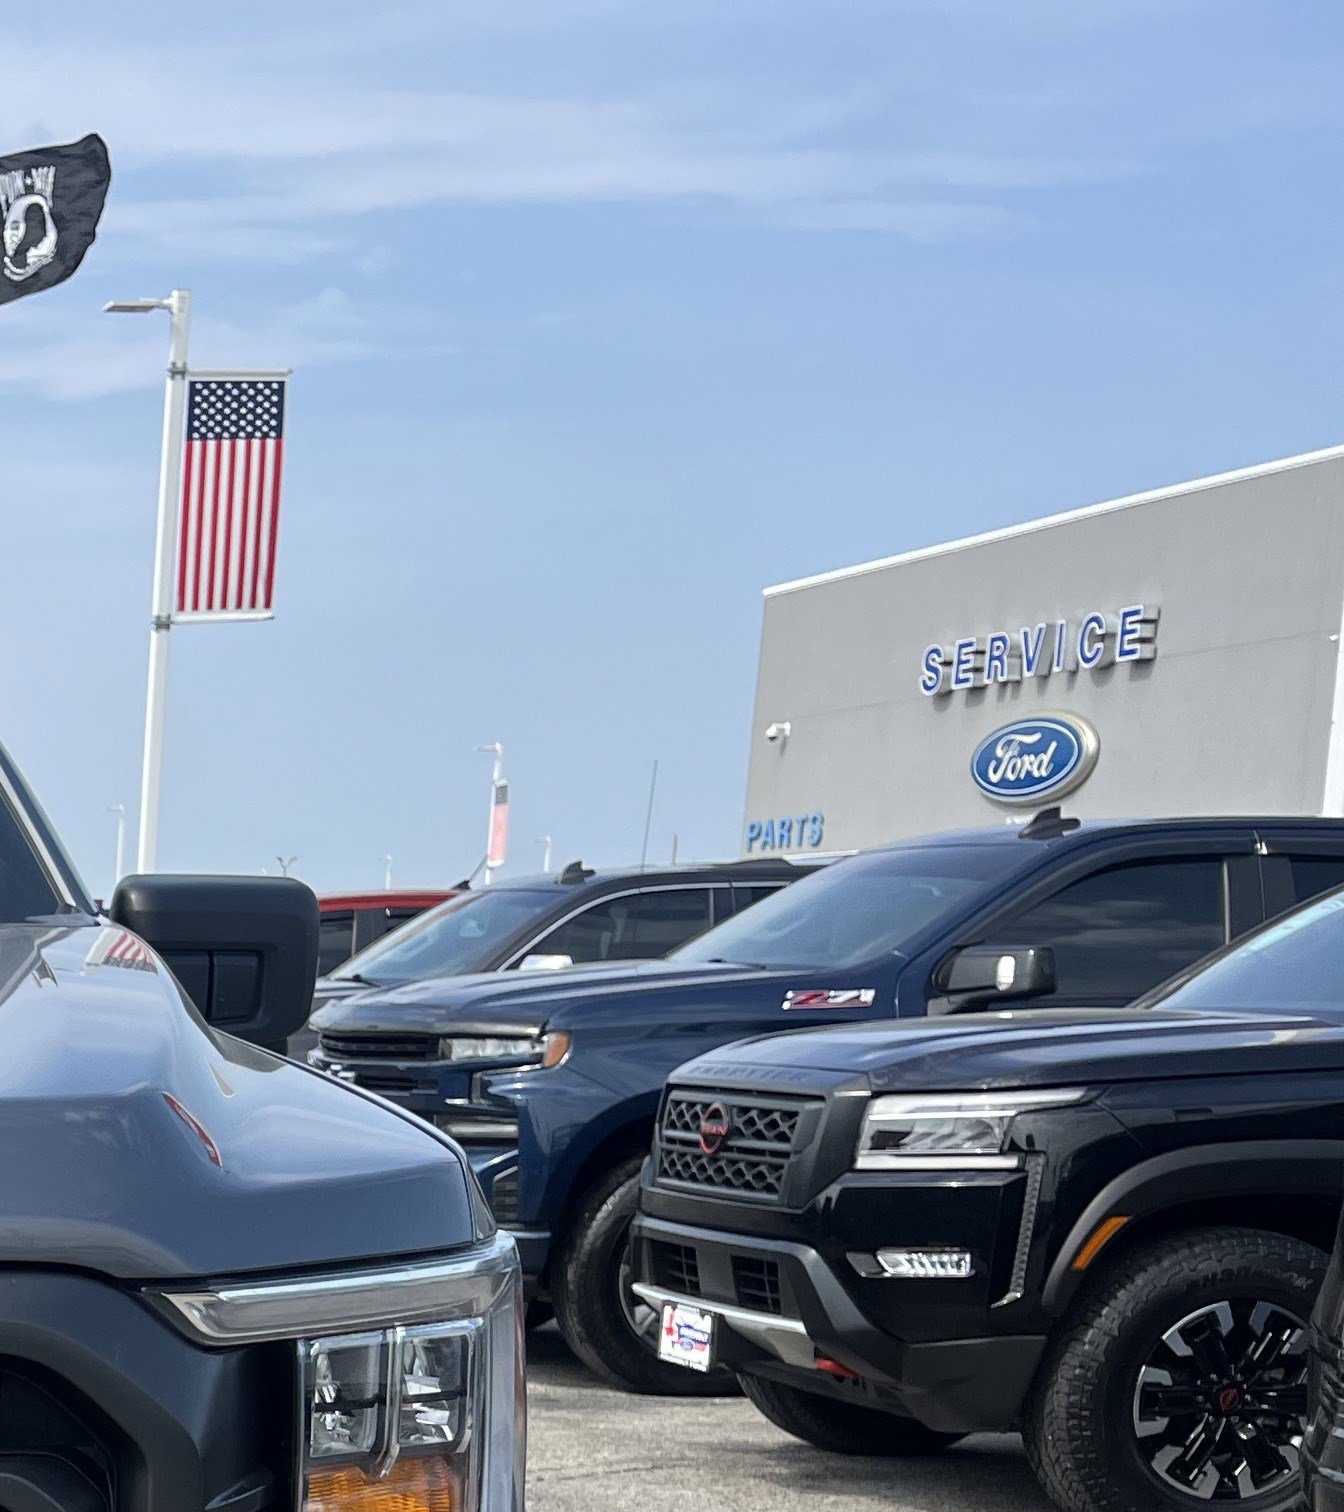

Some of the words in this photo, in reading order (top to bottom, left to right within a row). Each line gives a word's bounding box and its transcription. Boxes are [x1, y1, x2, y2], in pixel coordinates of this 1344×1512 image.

[919, 603, 1146, 697] SERVICE
[987, 731, 1059, 784] Ford
[746, 812, 825, 852] PARTS
